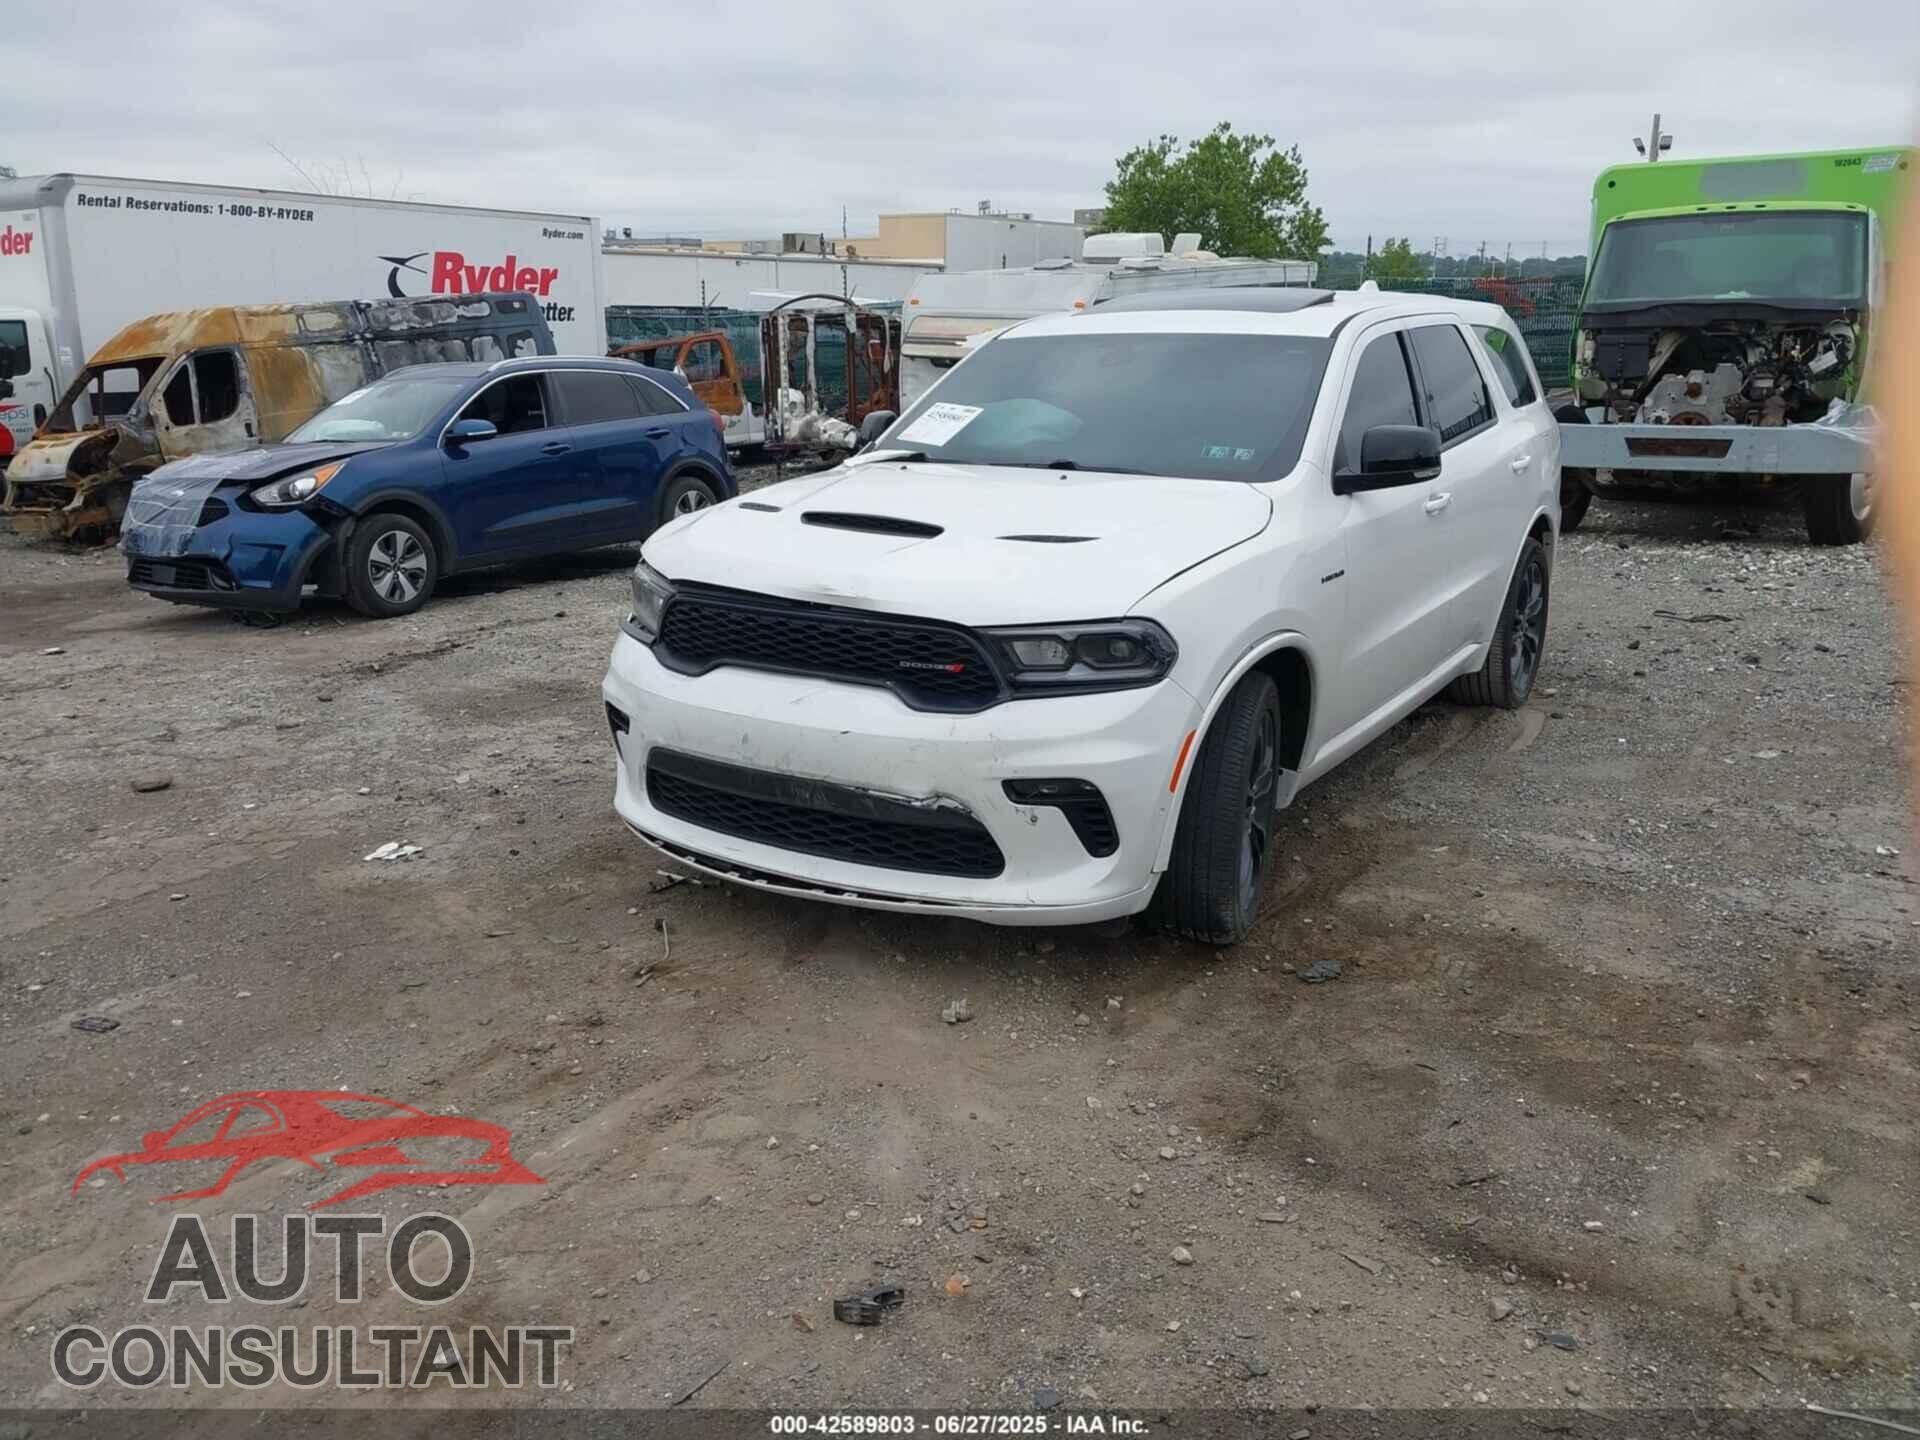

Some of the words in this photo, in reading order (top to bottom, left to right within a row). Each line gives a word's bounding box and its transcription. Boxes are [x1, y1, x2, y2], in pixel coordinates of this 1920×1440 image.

[77, 193, 121, 208] Rental
[126, 197, 213, 215] Reservations:
[218, 203, 314, 222] 1-800-BY-RYDER
[0, 224, 33, 256] der
[542, 227, 584, 240] Ryder.com
[431, 251, 559, 297] Ryder
[541, 302, 575, 322] tter.
